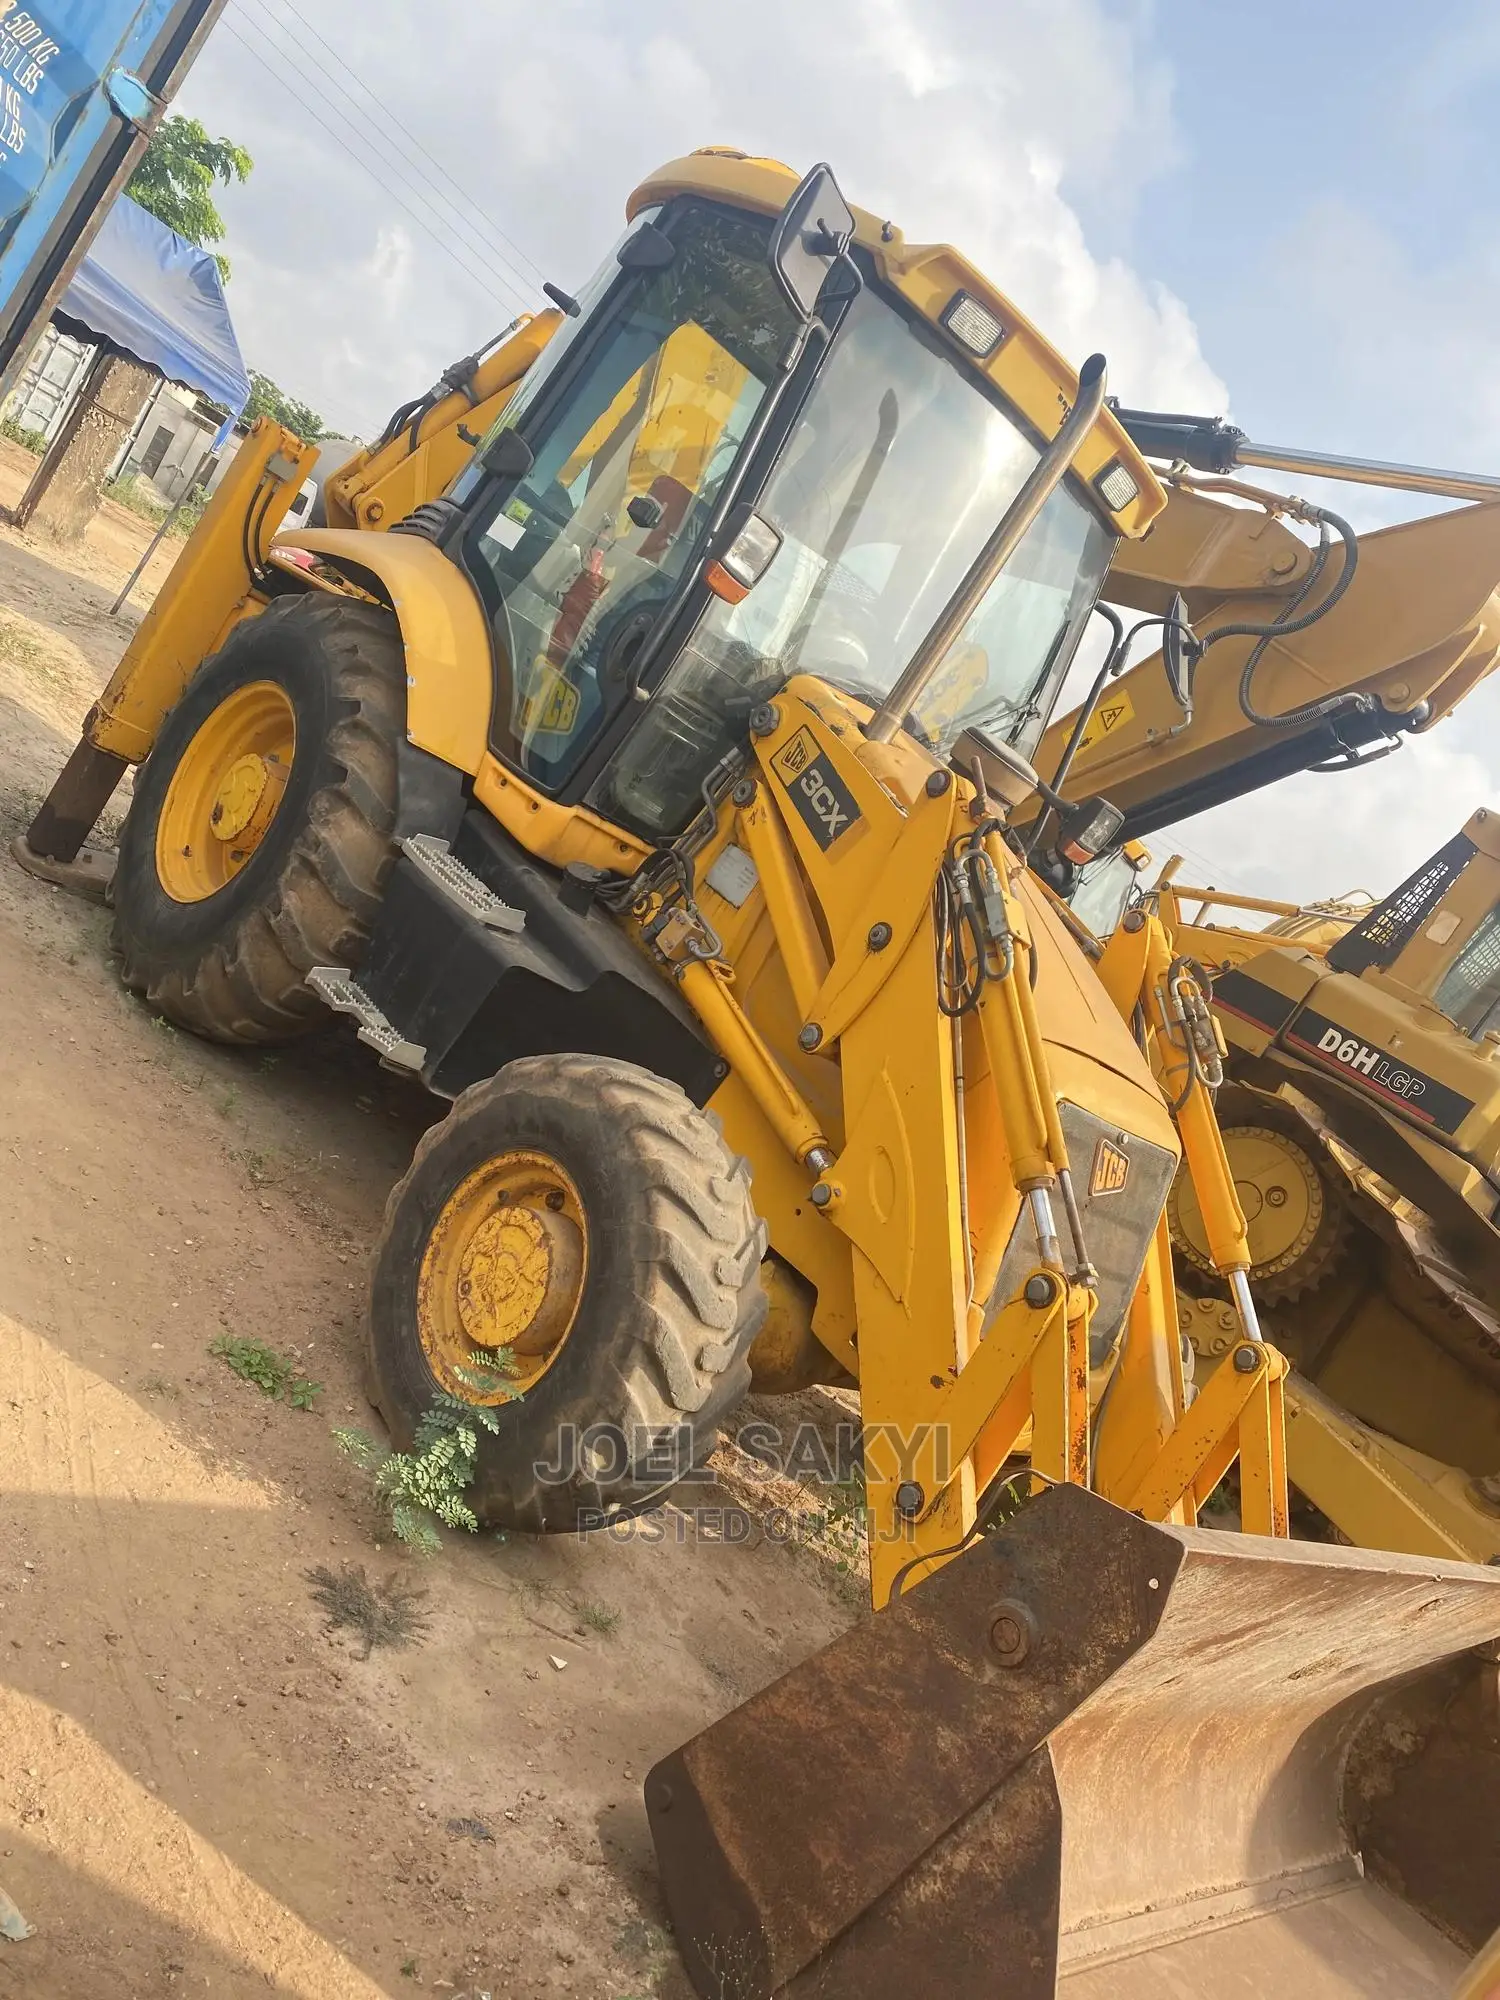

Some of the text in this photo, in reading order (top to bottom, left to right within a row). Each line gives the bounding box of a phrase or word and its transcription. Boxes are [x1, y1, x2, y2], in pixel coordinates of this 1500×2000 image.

[5, 12, 42, 46] 500
[28, 38, 60, 65] KG
[13, 54, 44, 95] LBS
[6, 83, 20, 121] KG
[0, 111, 26, 154] LBS
[782, 738, 808, 772] JCB
[800, 768, 849, 838] 3CX
[1316, 1027, 1426, 1099] D6H LGP
[1094, 1146, 1127, 1191] JCB
